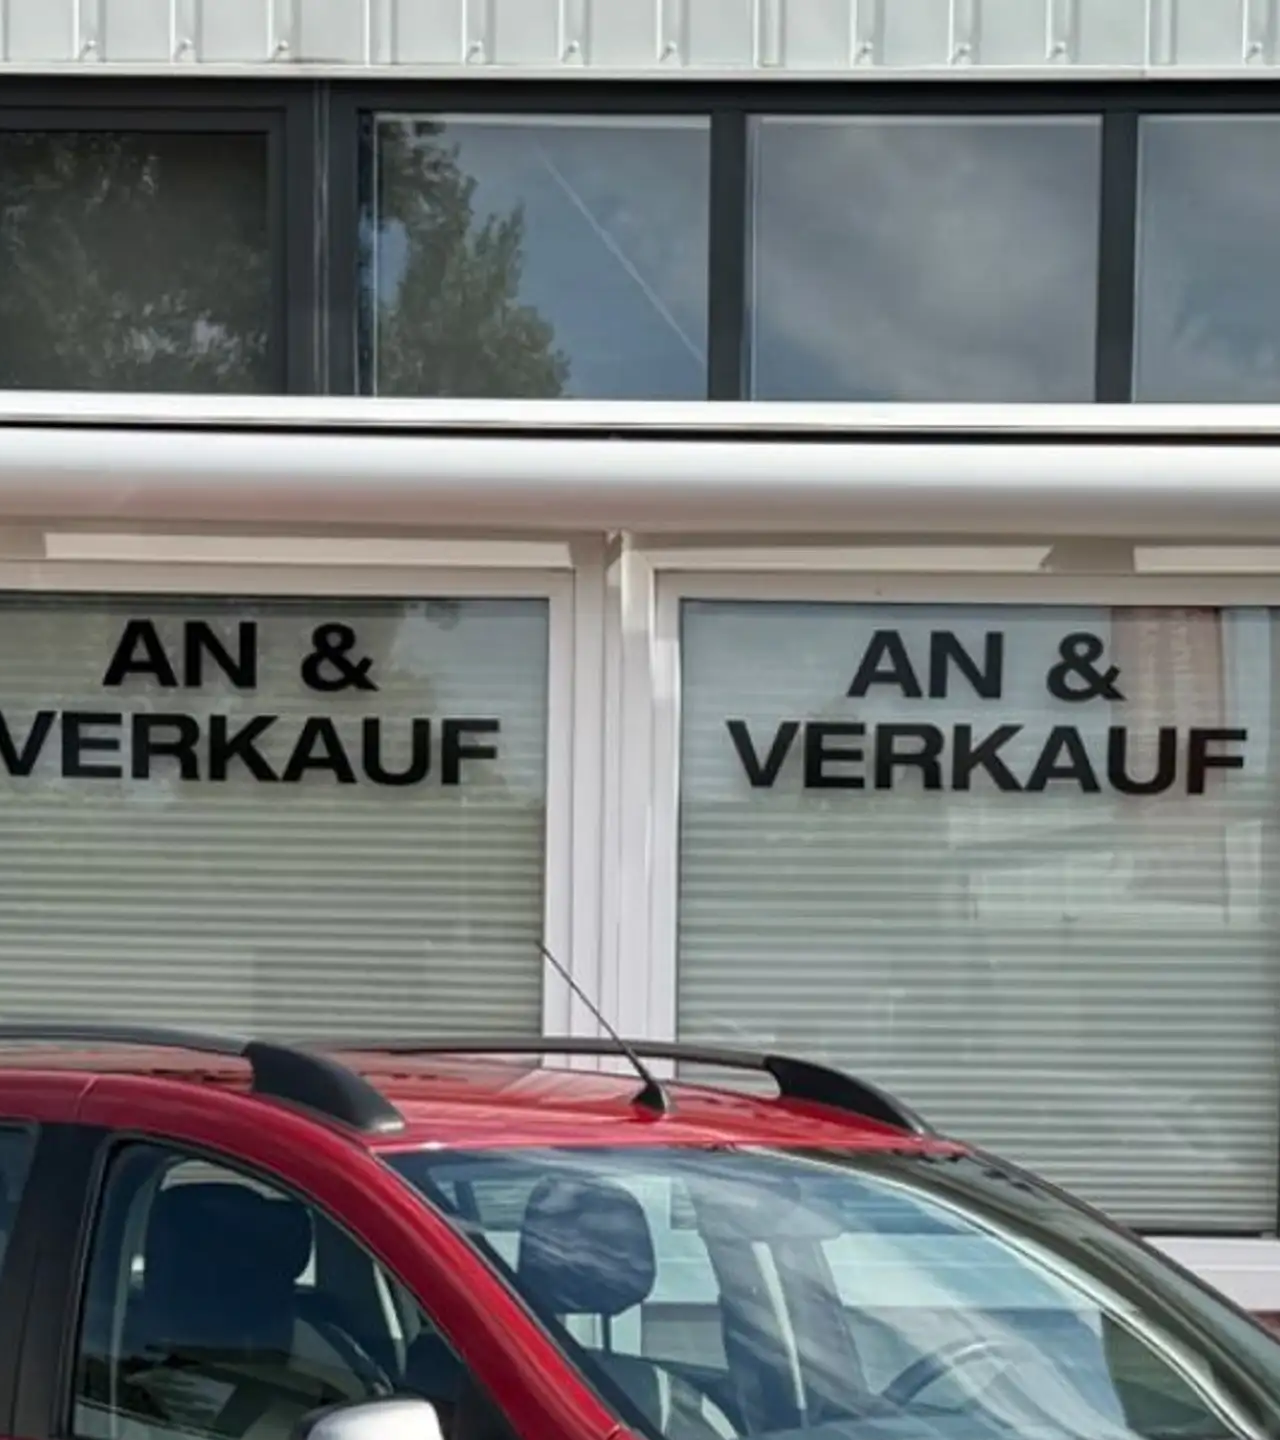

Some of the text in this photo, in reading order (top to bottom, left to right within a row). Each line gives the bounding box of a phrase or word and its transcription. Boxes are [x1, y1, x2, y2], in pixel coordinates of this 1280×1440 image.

[102, 619, 379, 692] AN &
[846, 629, 1125, 702] AN &
[726, 719, 1248, 796] VERKAUF
